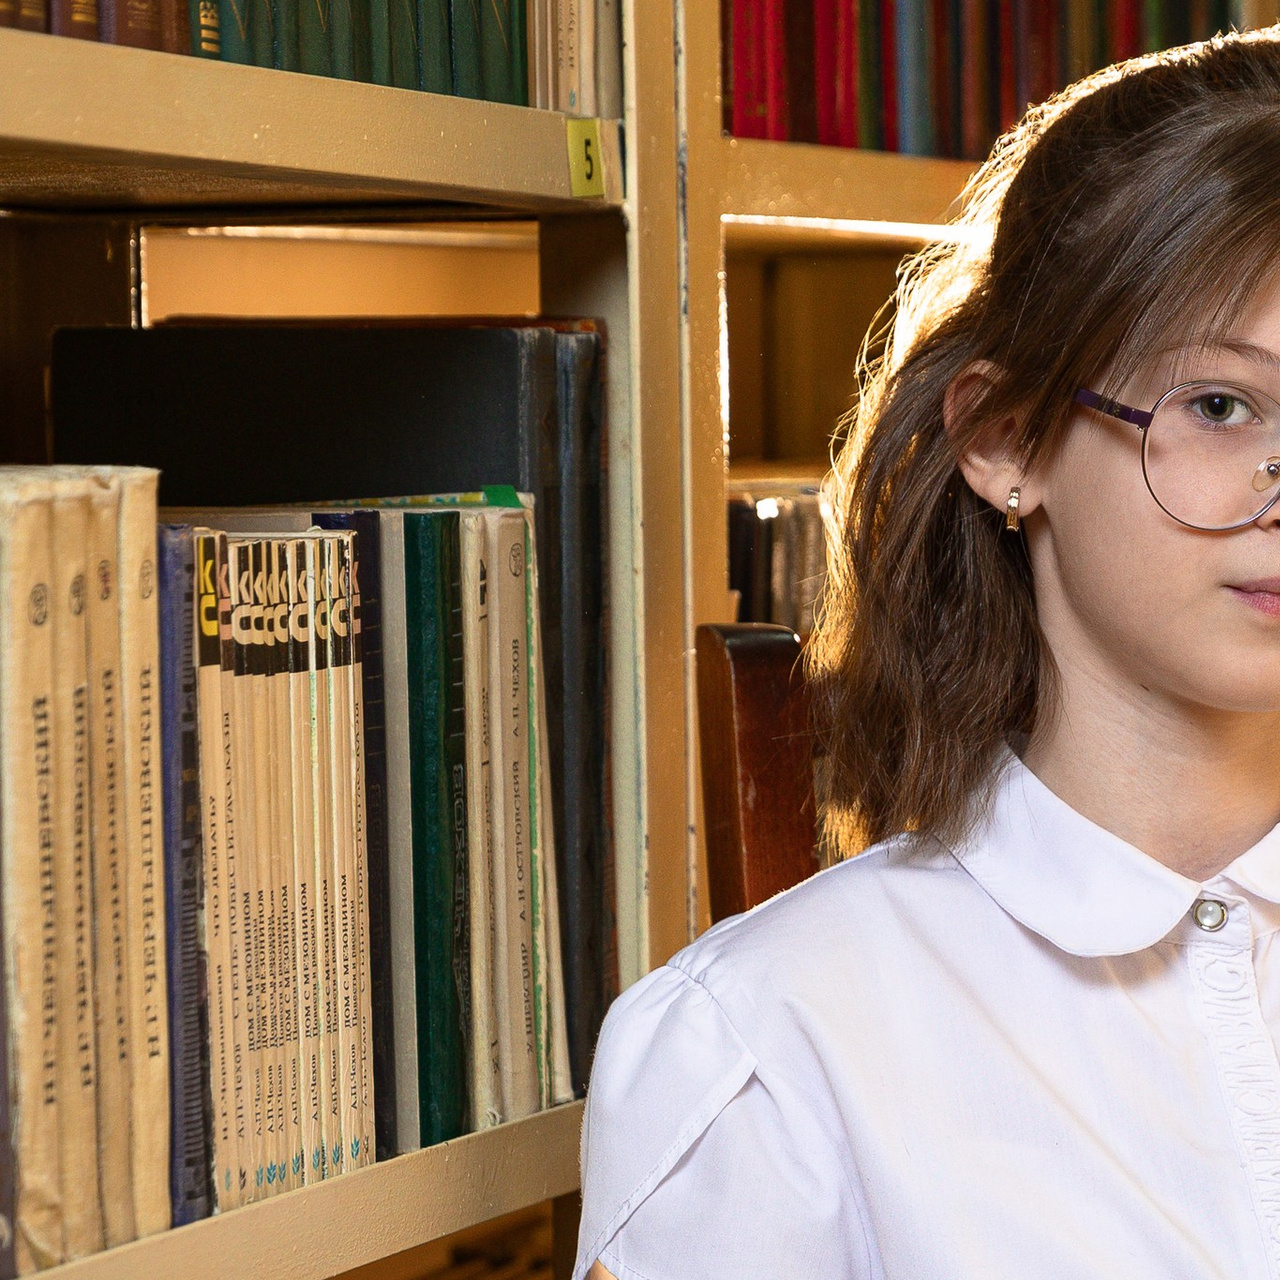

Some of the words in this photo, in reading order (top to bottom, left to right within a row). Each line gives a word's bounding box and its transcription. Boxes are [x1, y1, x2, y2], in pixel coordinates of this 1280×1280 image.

[585, 139, 594, 180] 5
[511, 638, 520, 706] ЧЕХОВ
[223, 711, 235, 825] РАССКАЗЫ
[140, 667, 157, 995] ЧЕРНЫШЕВСКИЙ
[209, 795, 219, 889] ДЕЛАТЬ?
[511, 760, 524, 882] ОСТРОВСКИЙ
[32, 695, 56, 1038] ЧЕРНЫШЕВСКИЙ
[227, 829, 239, 936] ПОВЕСТИ.
[243, 892, 253, 997] МЕЗОНИНОМ
[252, 918, 260, 979] рассказы
[256, 889, 267, 995] МЕЗОНИНОМ
[275, 916, 283, 976] рассказы
[281, 884, 291, 989] МЕЗОНИНОМ
[290, 911, 298, 968] рассказы
[301, 882, 311, 986] МЕЗОНИНОМ
[309, 908, 317, 967] рассказы
[322, 879, 331, 982] МЕЗОНИНОМ
[340, 874, 350, 976] МЕЗОНИНОМ
[349, 900, 357, 959] рассказы
[267, 992, 275, 1048] Повести
[291, 985, 299, 1042] Повести
[311, 981, 319, 1038] Повести
[324, 1001, 332, 1035] ДОМ
[344, 995, 353, 1029] ДОМ
[520, 942, 533, 1039] ШЕКСПИР
[247, 1017, 256, 1053] ДОМ
[254, 995, 262, 1052] Повести
[260, 1016, 269, 1050] ДОМ
[284, 1009, 293, 1043] ДОМ
[304, 1005, 313, 1039] ДОМ
